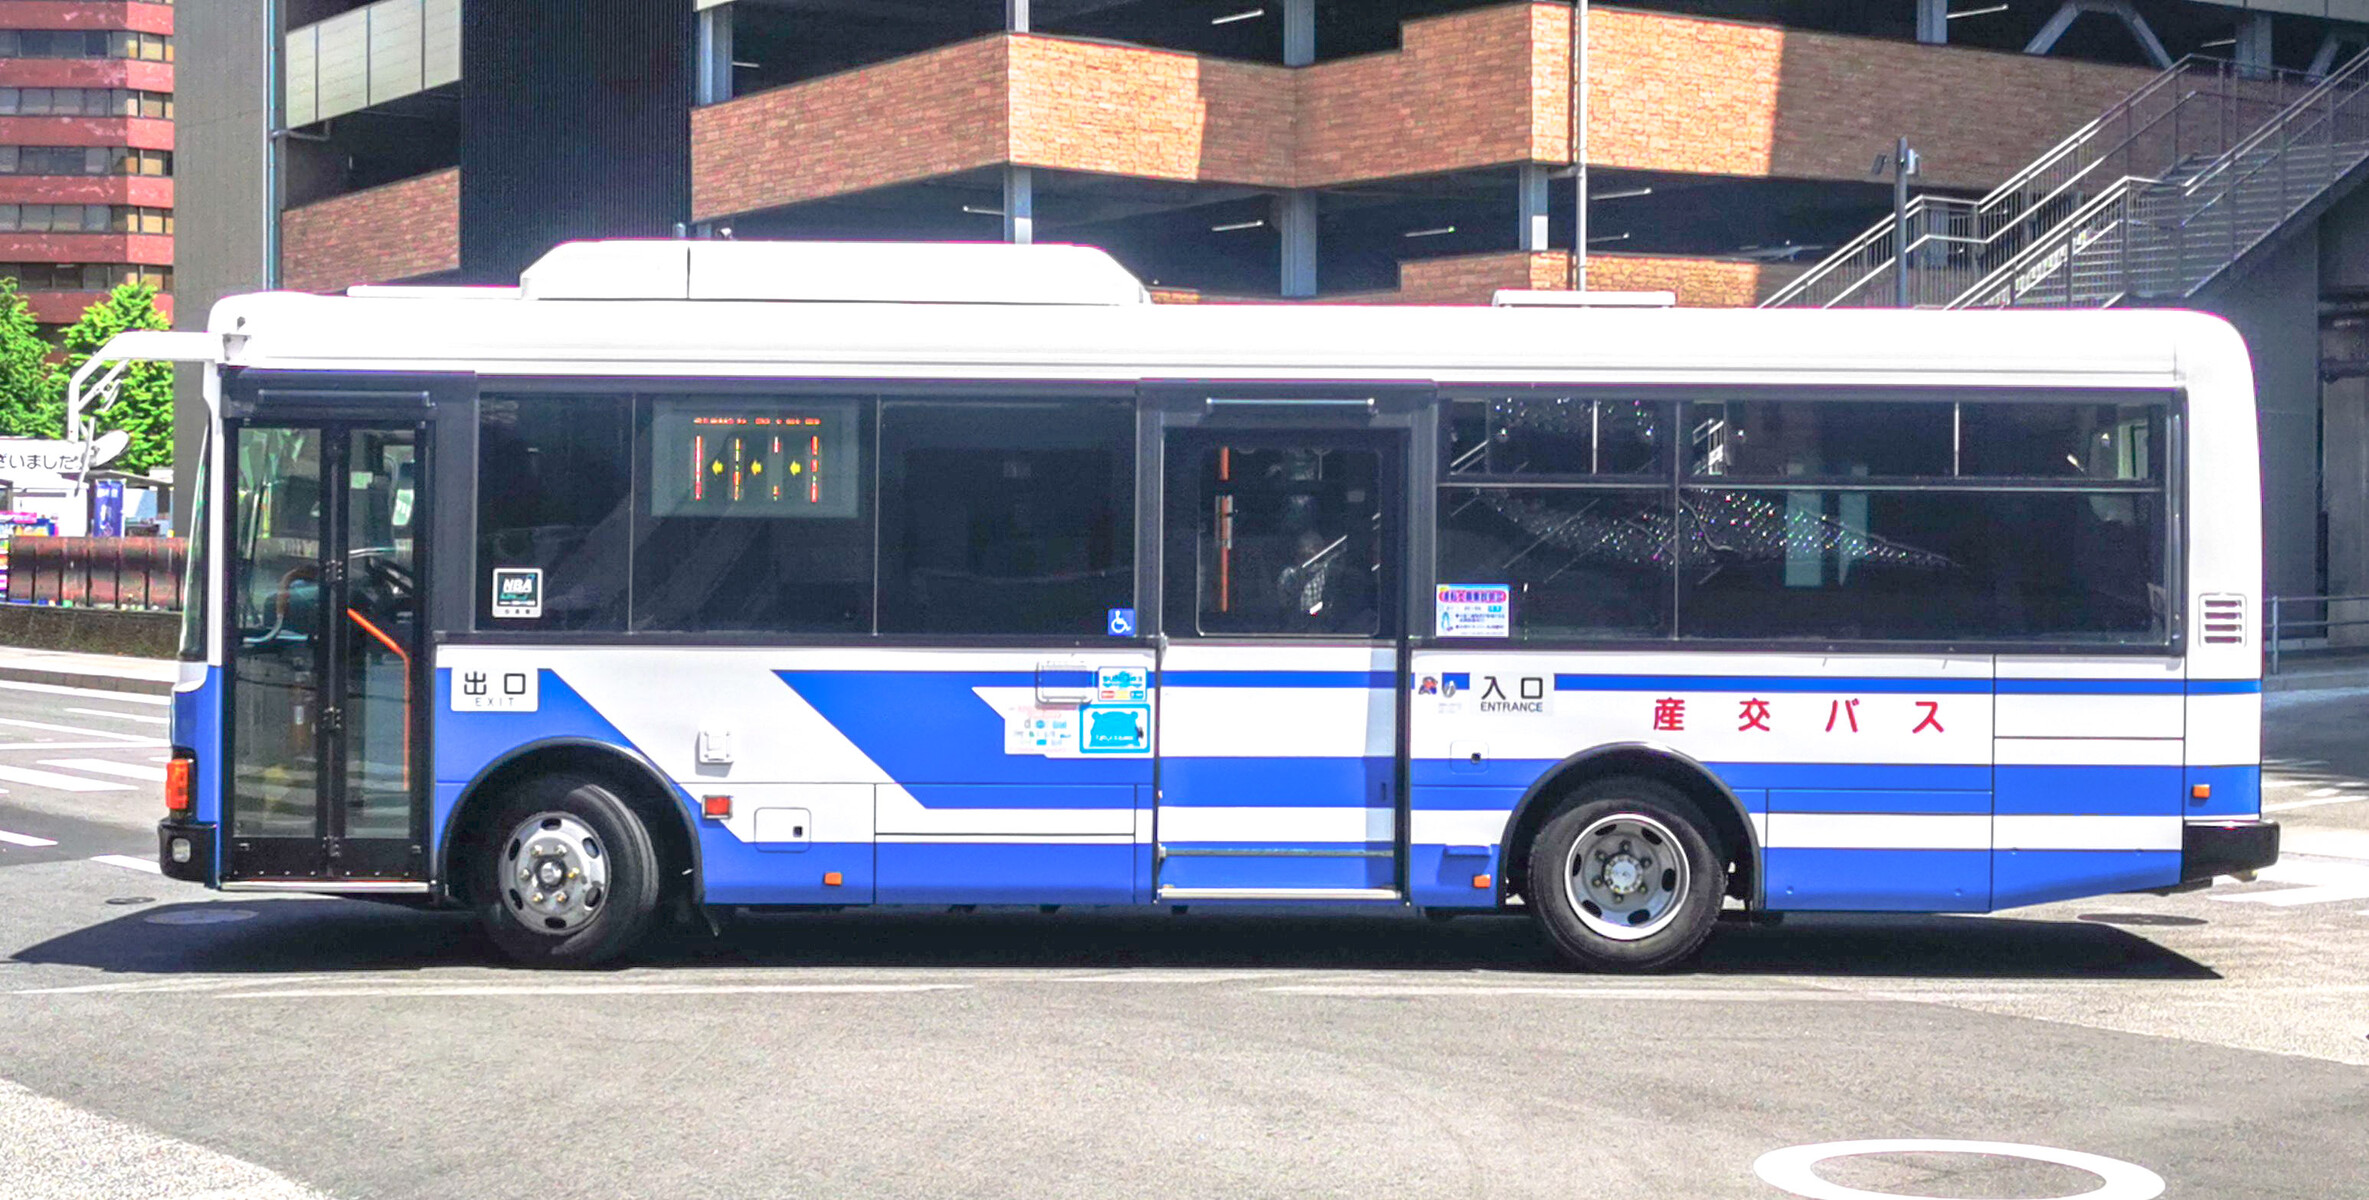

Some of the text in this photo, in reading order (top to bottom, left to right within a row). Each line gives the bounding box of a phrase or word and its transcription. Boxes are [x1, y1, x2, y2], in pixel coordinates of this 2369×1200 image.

[463, 671, 526, 695] 出口
[1481, 676, 1543, 700] 入口
[475, 697, 514, 706] EXIT
[1480, 702, 1543, 712] ENTRANCE
[1653, 697, 1945, 733] 産交バス
